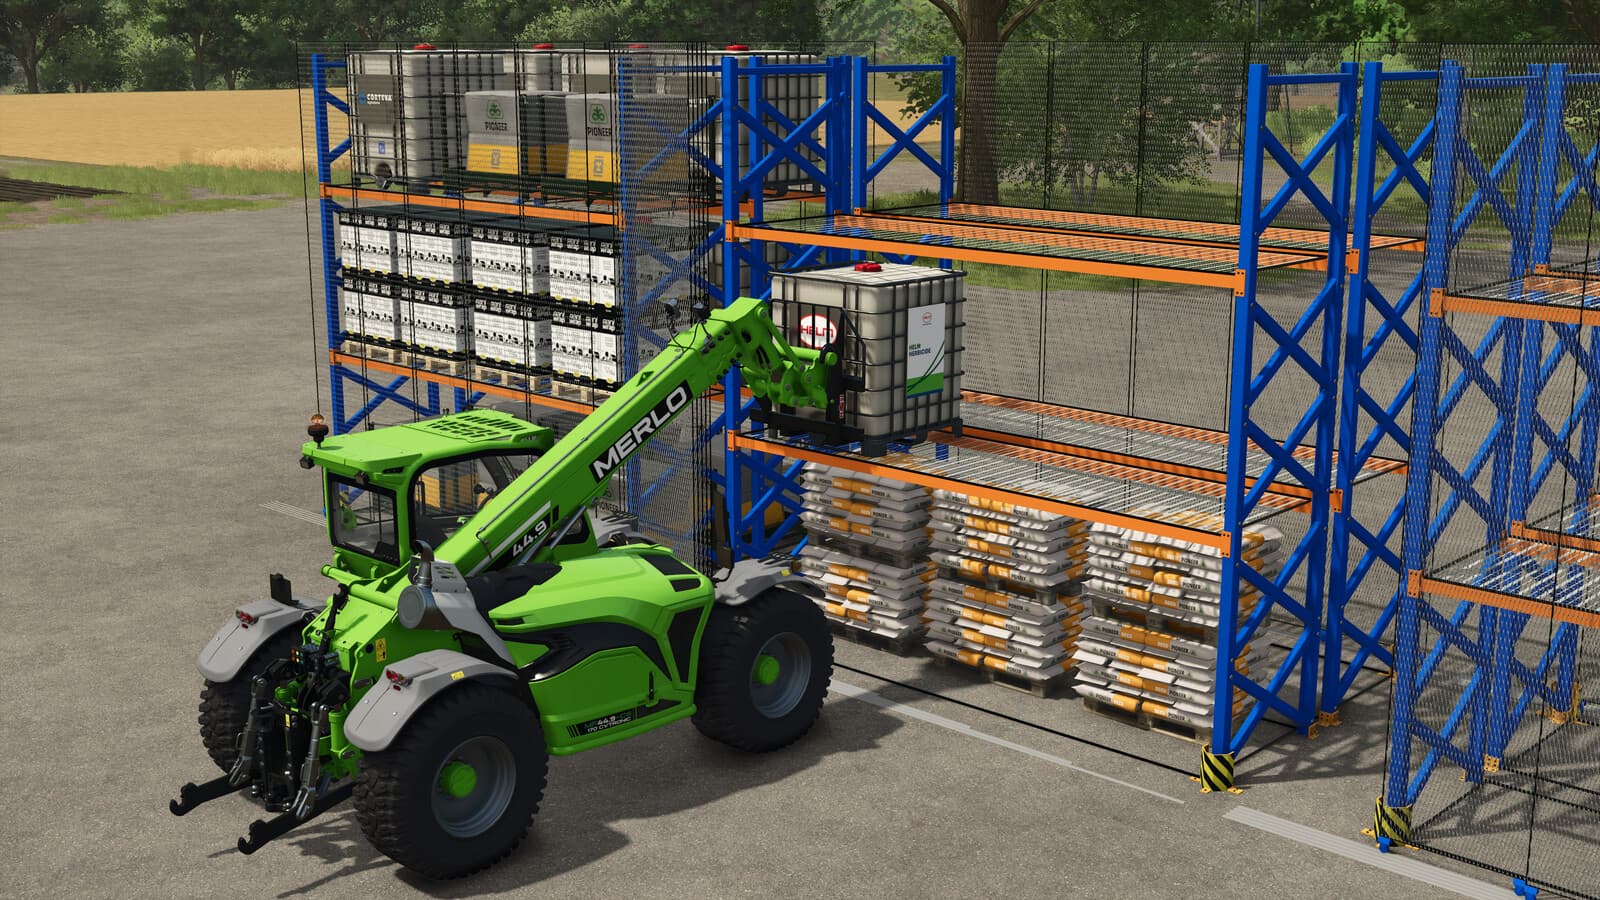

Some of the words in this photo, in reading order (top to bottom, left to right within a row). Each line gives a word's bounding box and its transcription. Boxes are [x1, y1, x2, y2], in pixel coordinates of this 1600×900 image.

[484, 121, 508, 131] PIONEER
[587, 126, 612, 137] PIONEER
[593, 386, 687, 479] MERLO
[512, 520, 547, 557] 44.9
